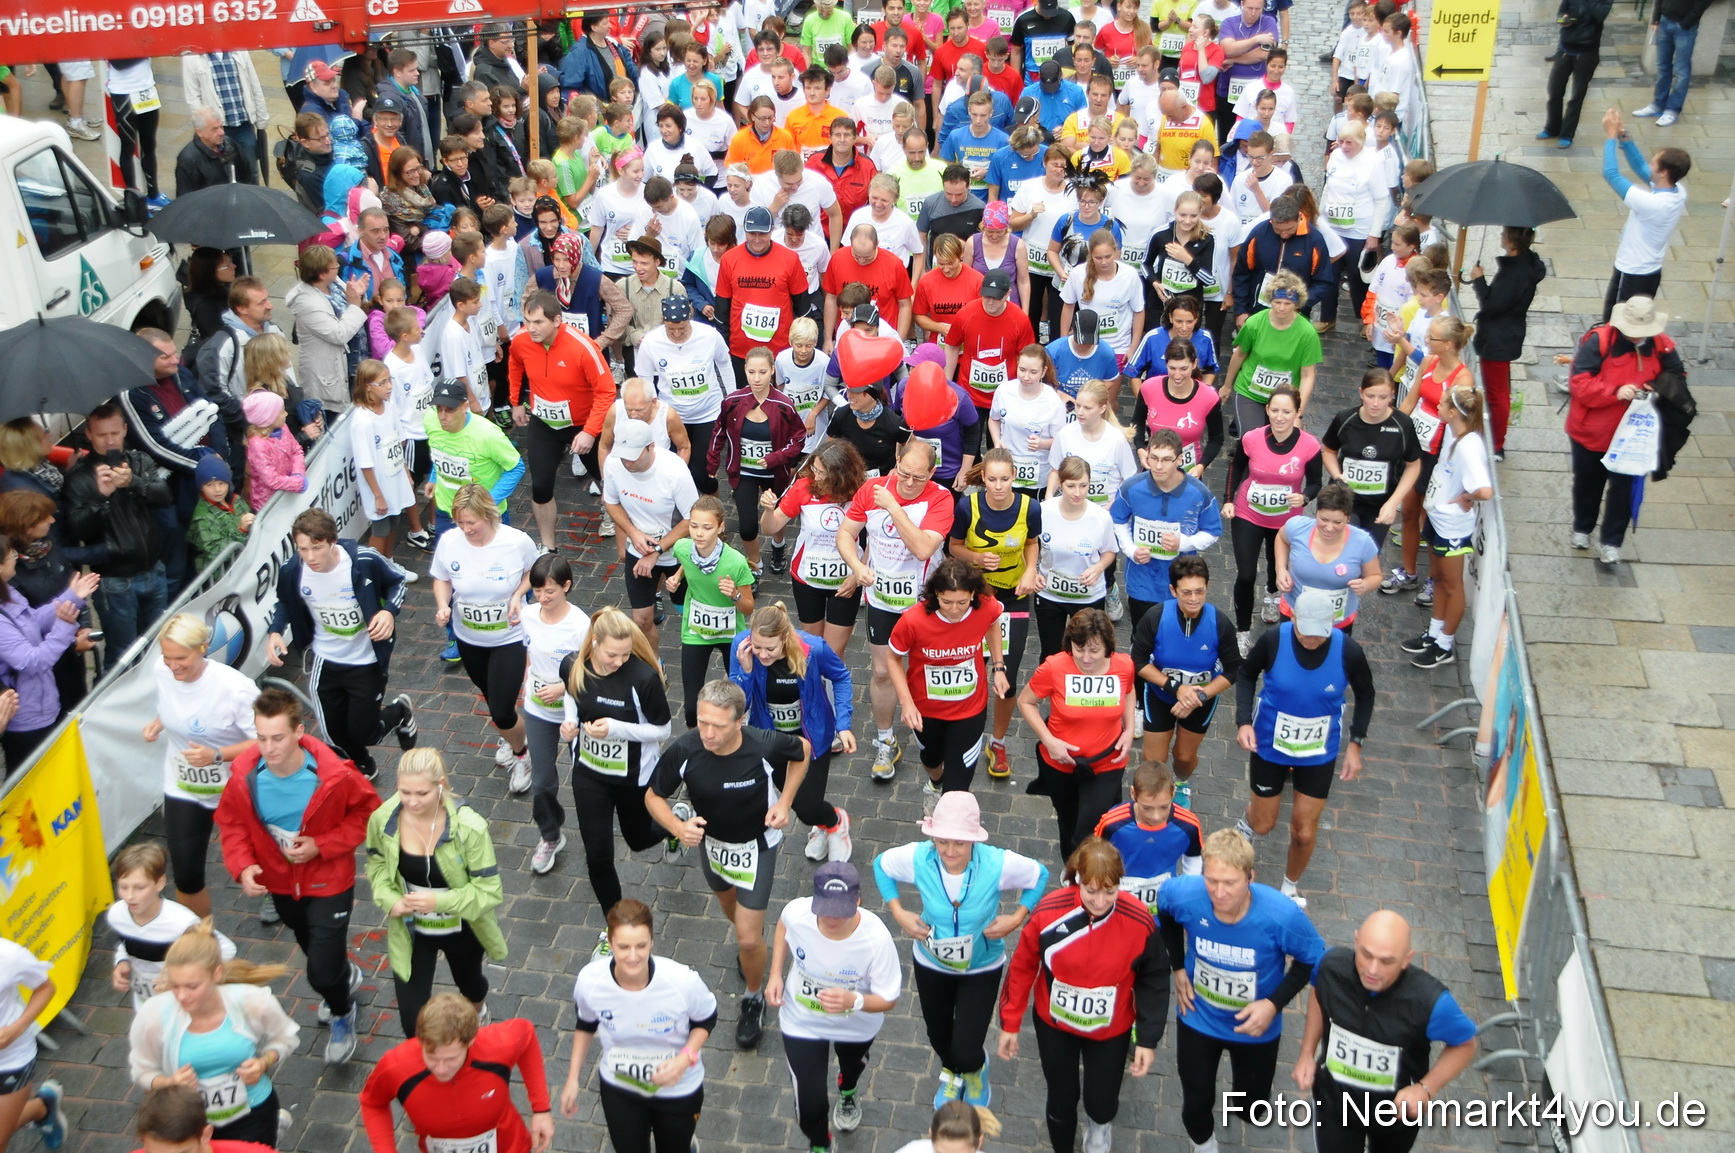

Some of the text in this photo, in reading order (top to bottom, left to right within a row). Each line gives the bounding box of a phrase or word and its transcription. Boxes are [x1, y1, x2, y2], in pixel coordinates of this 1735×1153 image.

[131, 3, 205, 30] 09181
[212, 0, 277, 23] 6352
[1433, 10, 1495, 29] Jugend-
[1448, 29, 1478, 43] lauf
[1035, 45, 1057, 57] 5140
[1162, 39, 1184, 50] 5130
[1162, 131, 1176, 139] MAX
[910, 202, 922, 213] 50
[1328, 206, 1354, 218] 5178
[1029, 249, 1048, 263] 504
[1122, 249, 1143, 262] 504
[1165, 267, 1194, 283] 5123
[745, 312, 776, 329] 5184
[1099, 316, 1115, 328] 45
[671, 373, 706, 389] 5119
[973, 368, 1004, 384] 5066
[788, 391, 819, 405] 5143
[536, 406, 566, 421] 5151
[741, 443, 773, 458] 5135
[433, 459, 466, 477] 5032
[1347, 466, 1383, 483] 5025
[1087, 484, 1105, 496] 82
[1251, 492, 1288, 506] 5169
[1138, 528, 1168, 544] 505
[809, 562, 848, 578] 5120
[875, 577, 912, 596] 5106
[1052, 575, 1088, 594] 5053
[319, 610, 360, 626] 5139
[463, 607, 503, 622] 5017
[693, 609, 729, 629] 5011
[922, 644, 976, 660] NEUMARKT
[931, 669, 974, 686] 5075
[1071, 676, 1115, 694] 5079
[1080, 698, 1105, 706] Christa
[1279, 724, 1323, 742] 5174
[583, 736, 622, 760] 5092
[591, 757, 609, 768] Linda
[178, 764, 221, 784] 5005
[728, 779, 756, 789] PFLEIDERER
[51, 795, 82, 837] KAN
[711, 844, 752, 869] 5093
[7, 890, 37, 928] Pflaster
[13, 880, 67, 942] Außenplatten
[1195, 936, 1256, 959] HUBER
[1199, 970, 1249, 999] 5112
[1055, 989, 1108, 1016] 5103
[1206, 991, 1238, 1007] Thomas
[1064, 1011, 1093, 1025] Andrea
[1335, 1040, 1390, 1072] 5113
[615, 1062, 656, 1083] 506
[1341, 1065, 1376, 1083] Thomas
